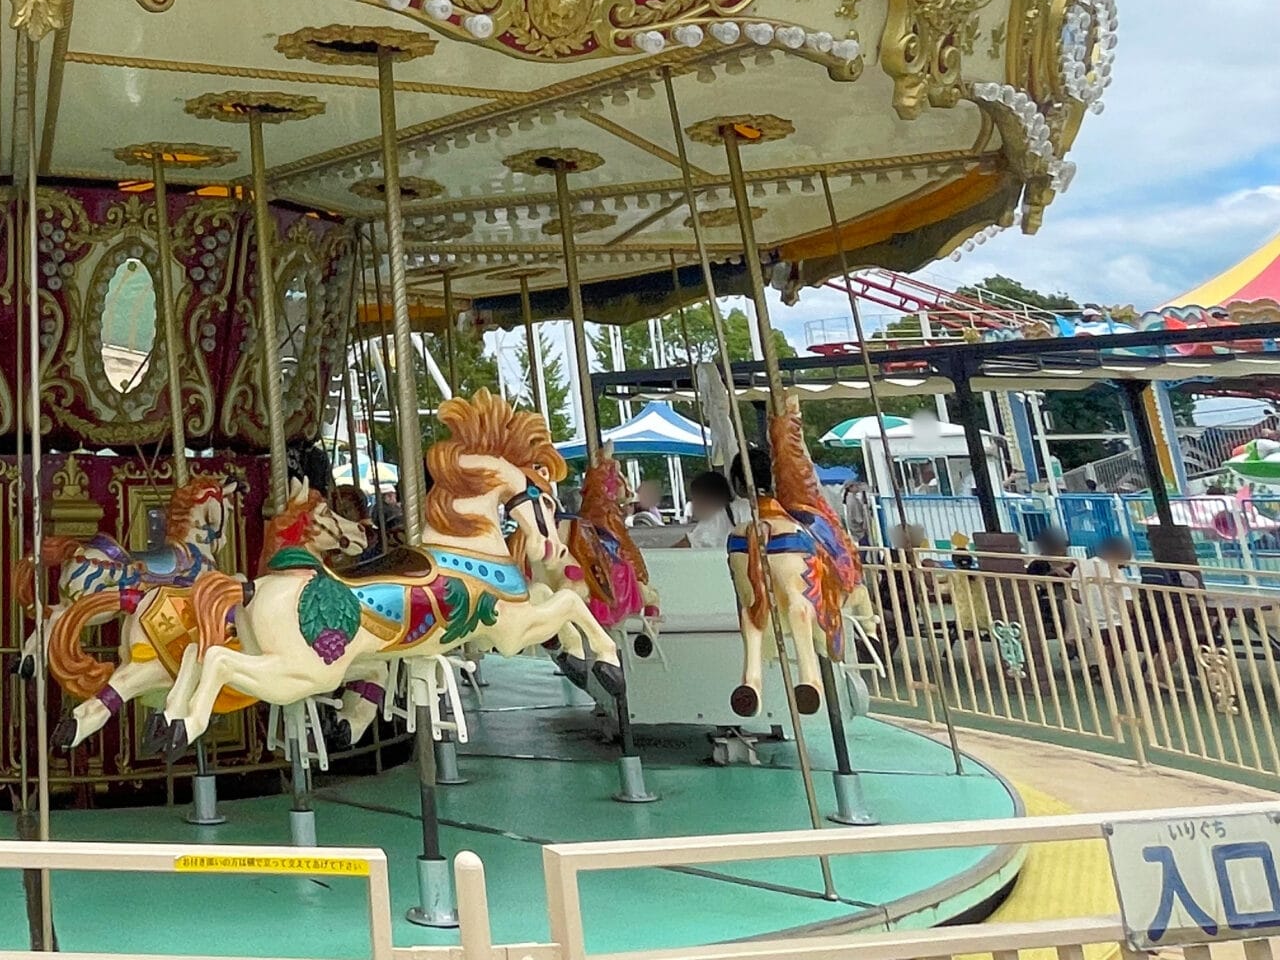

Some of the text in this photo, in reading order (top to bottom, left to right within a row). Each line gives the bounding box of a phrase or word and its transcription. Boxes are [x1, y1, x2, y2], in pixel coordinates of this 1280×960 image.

[1167, 820, 1227, 841] いりぐち
[1142, 841, 1280, 942] 入口
